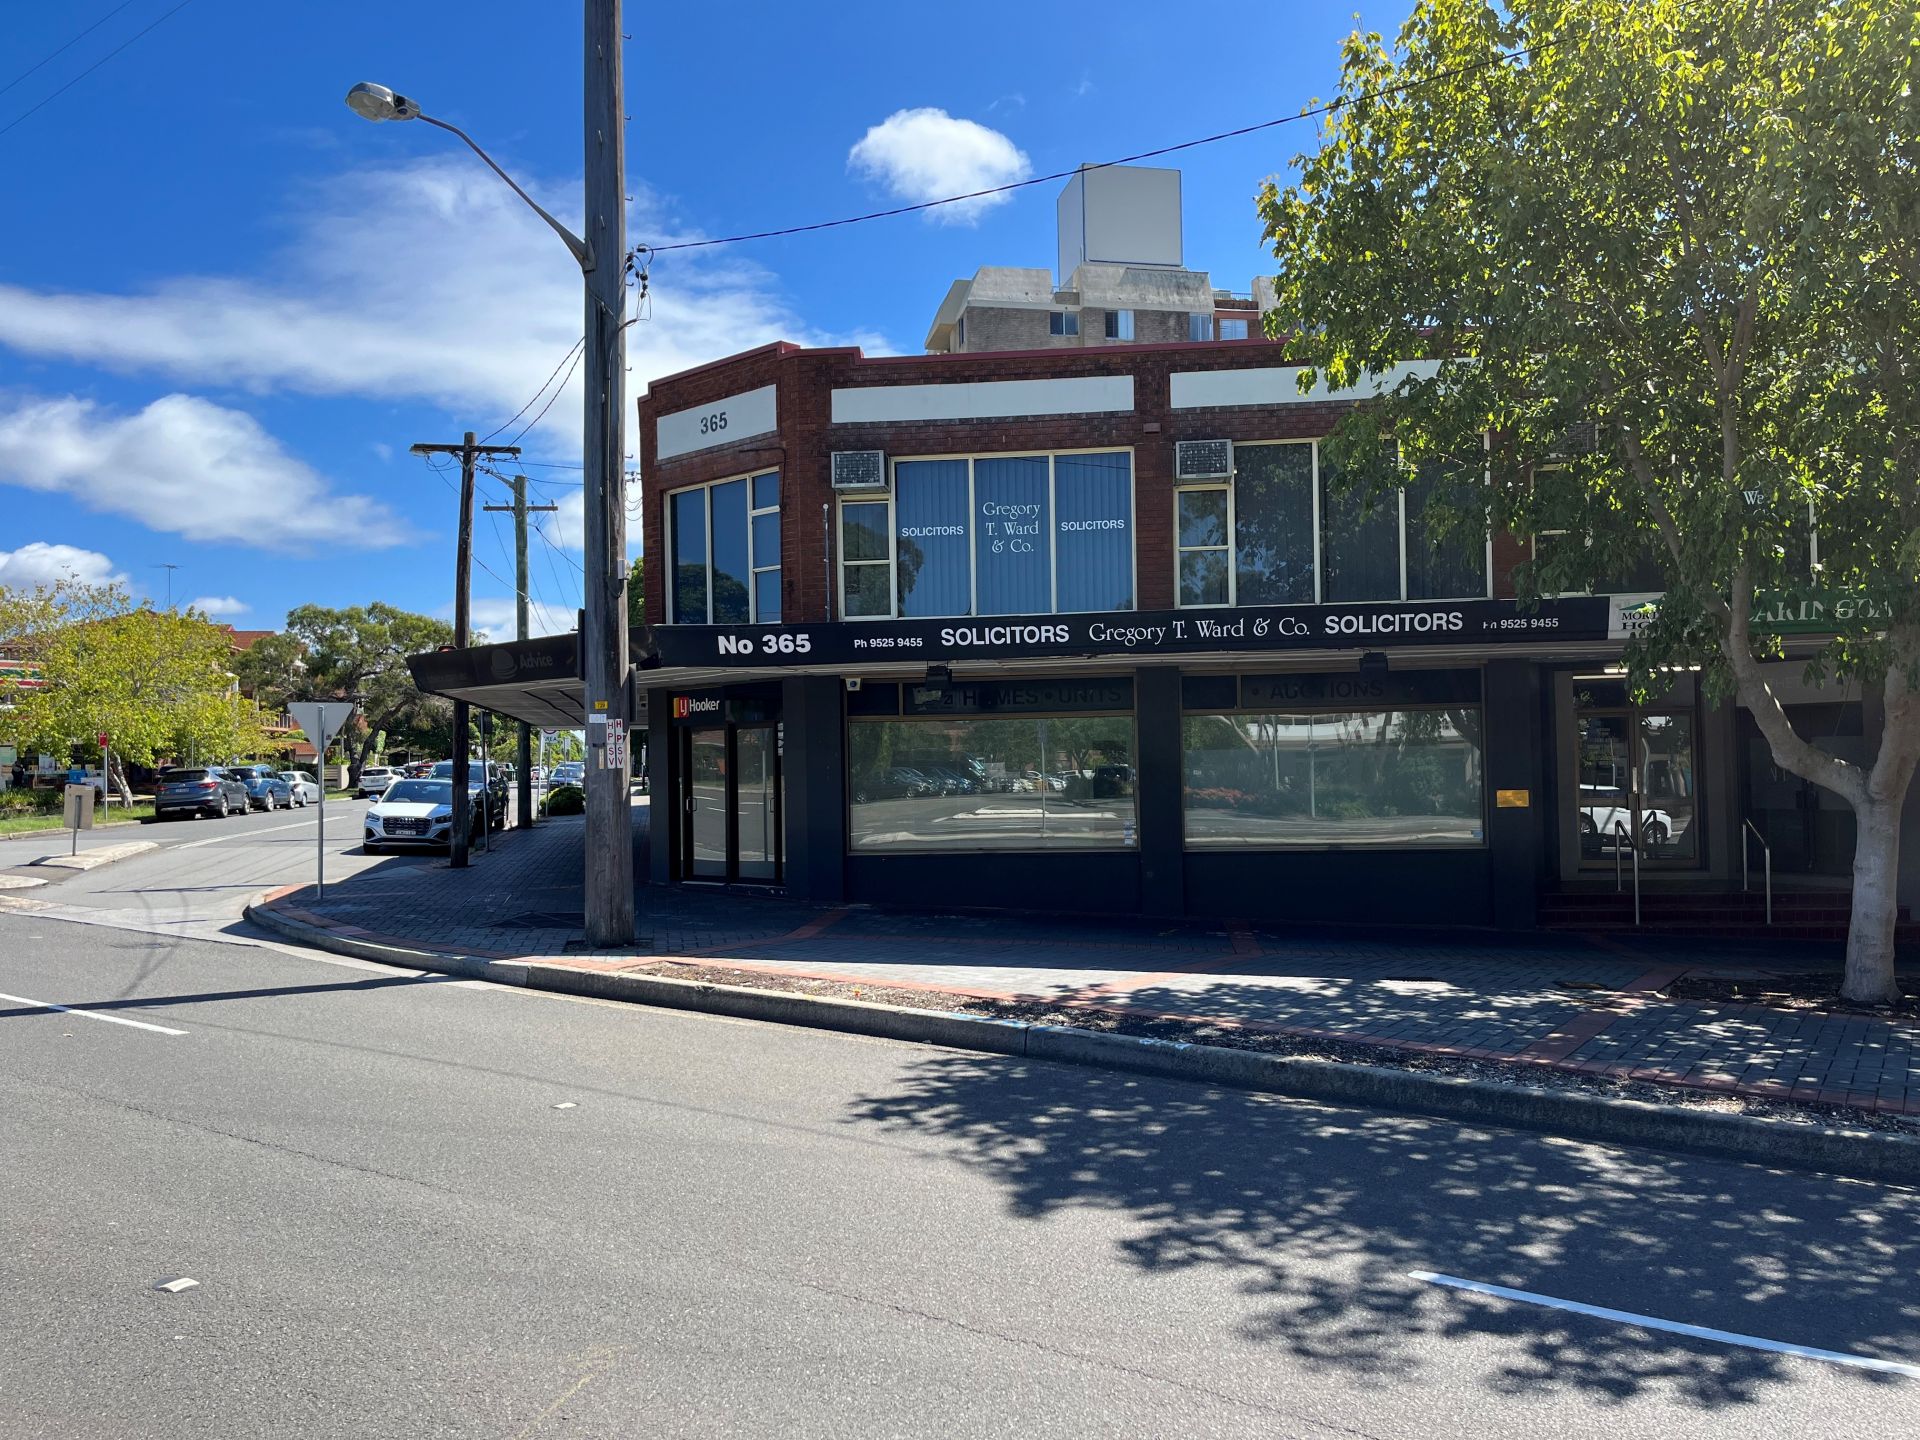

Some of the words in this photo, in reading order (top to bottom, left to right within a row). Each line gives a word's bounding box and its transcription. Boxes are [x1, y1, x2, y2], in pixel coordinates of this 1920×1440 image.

[700, 411, 728, 435] 365
[982, 501, 1041, 519] Gregory
[901, 525, 964, 537] SOLICITORS
[985, 522, 998, 536] T.
[1004, 520, 1040, 535] Ward
[1060, 519, 1125, 531] SOLICITORS
[991, 540, 1005, 554] &
[1010, 538, 1035, 553] Co.
[940, 624, 1070, 647] SOLICITORS
[1088, 622, 1167, 647] Gregory
[1172, 619, 1188, 639] T.
[1194, 617, 1245, 638] Ward
[1252, 617, 1271, 637] &
[1278, 616, 1311, 636] Co.
[1324, 611, 1464, 634] SOLICITORS
[1500, 618, 1528, 629] 9525
[1530, 617, 1560, 629] 9455
[717, 635, 754, 655] No
[762, 633, 812, 654] 365
[853, 639, 868, 649] Ph
[869, 638, 895, 648] 9525
[897, 637, 923, 647] 9455
[519, 651, 553, 670] Advice
[689, 697, 720, 712] Hooker
[962, 687, 1039, 706] HMES
